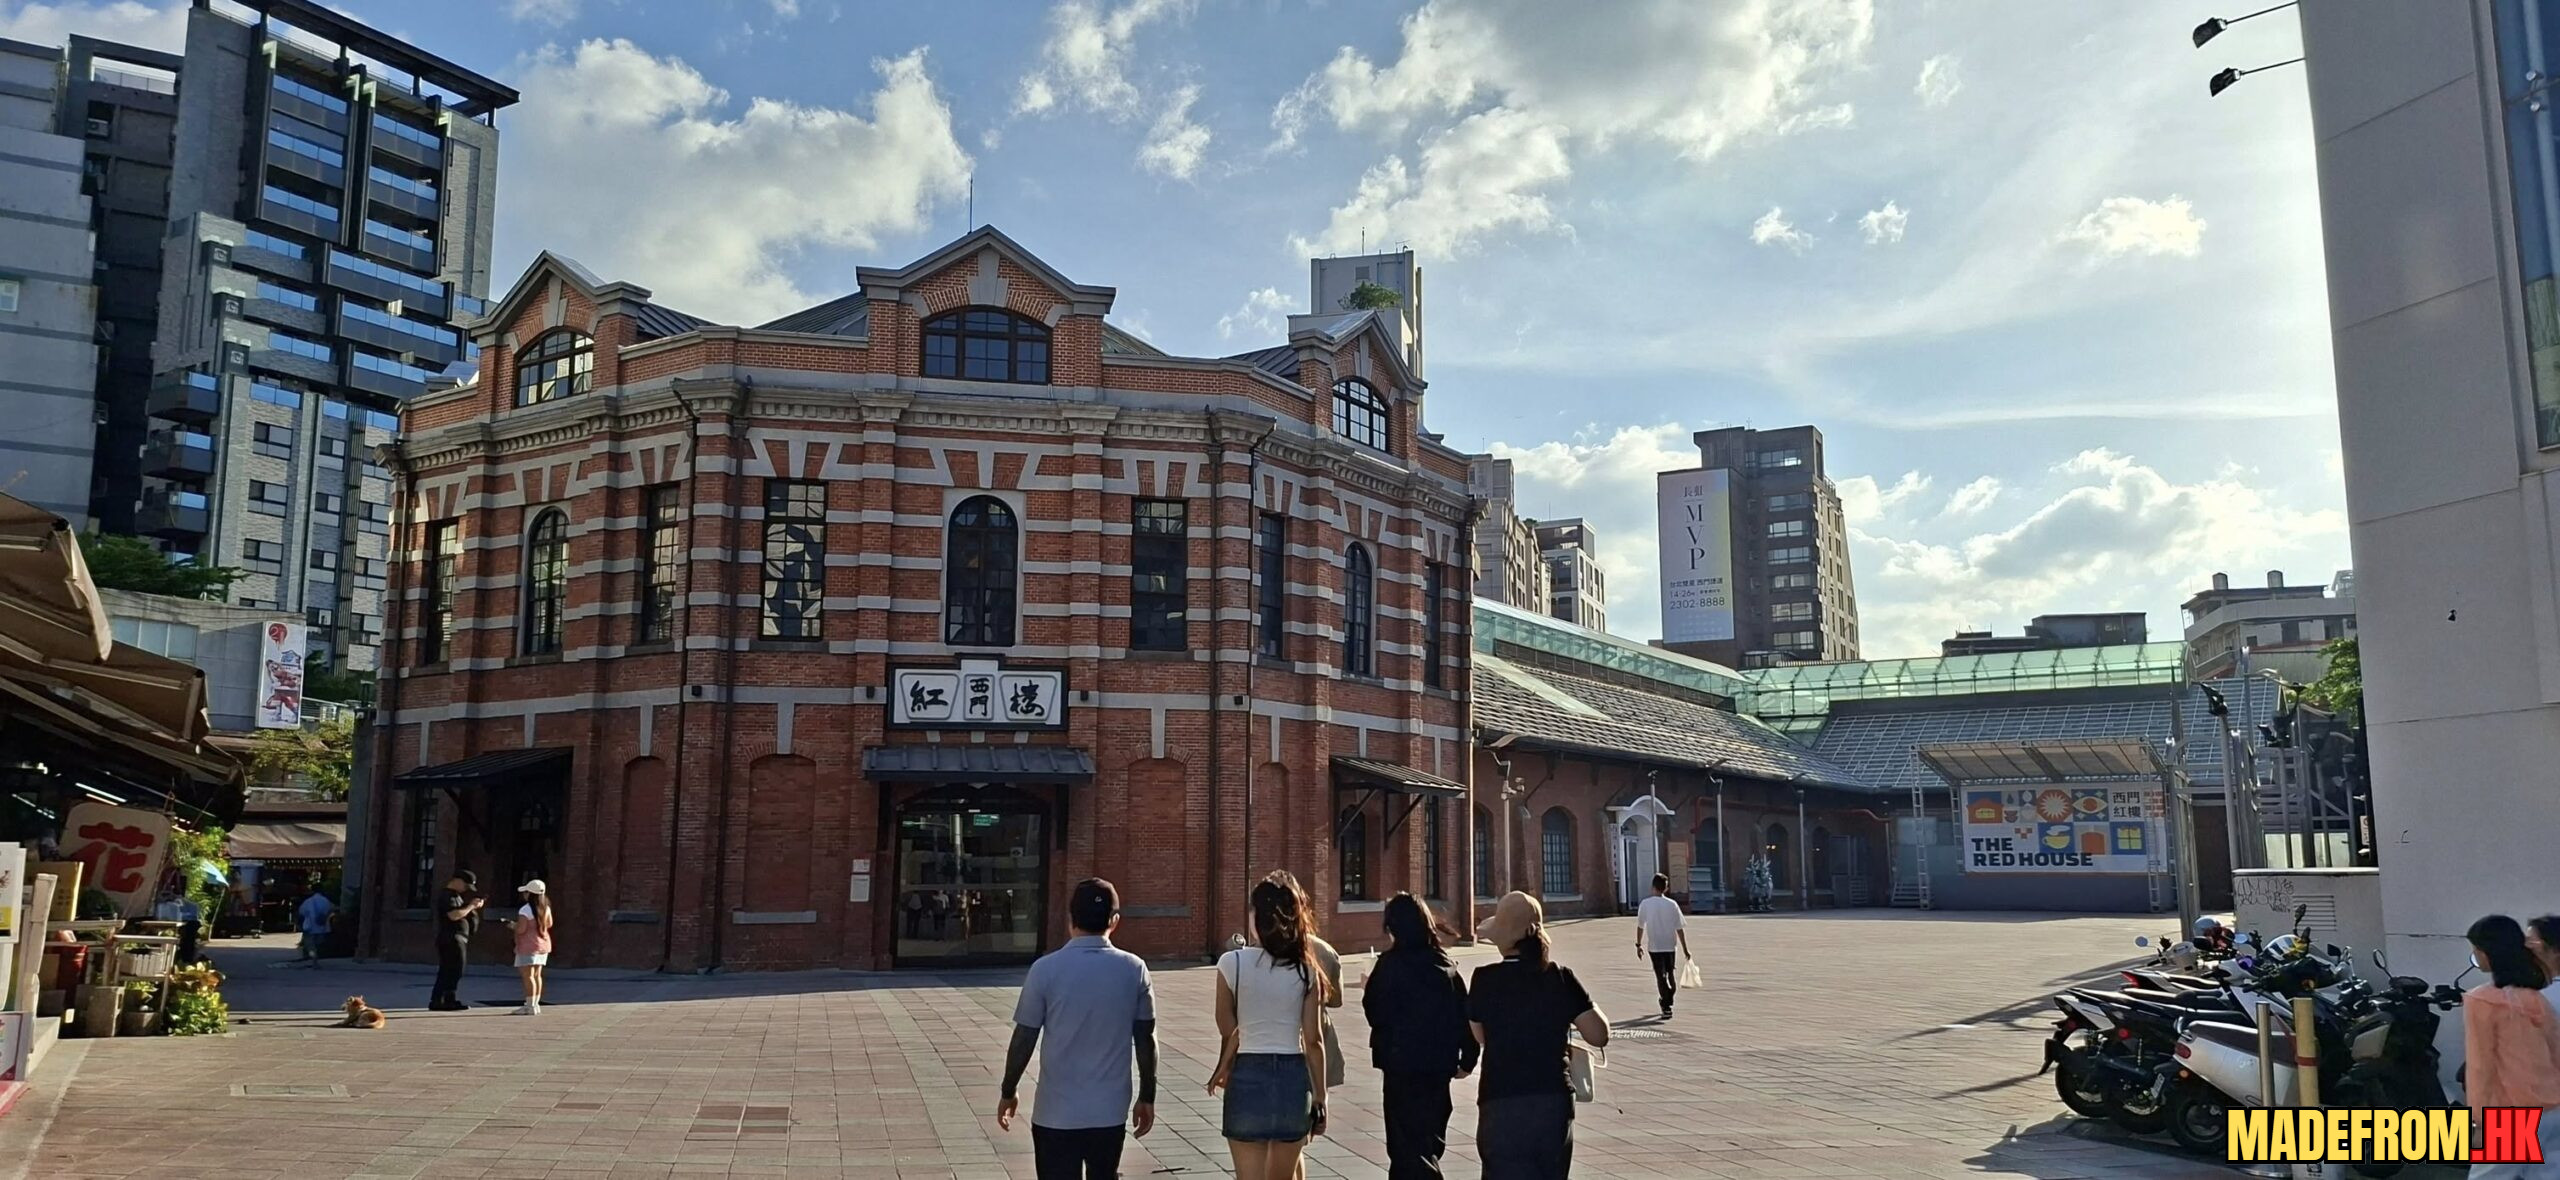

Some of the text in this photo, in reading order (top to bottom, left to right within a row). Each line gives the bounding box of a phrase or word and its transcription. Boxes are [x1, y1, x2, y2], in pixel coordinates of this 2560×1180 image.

[1685, 504, 1705, 570] MVP
[1670, 597, 1725, 610] 2302-8888
[910, 680, 948, 713] 紅
[969, 678, 990, 717] 西門
[2112, 791, 2140, 804] 西門
[2113, 805, 2141, 818] 紅樓
[1971, 837, 2014, 852] THE
[69, 821, 155, 893] 花
[1973, 852, 2093, 867] RED HOUSE
